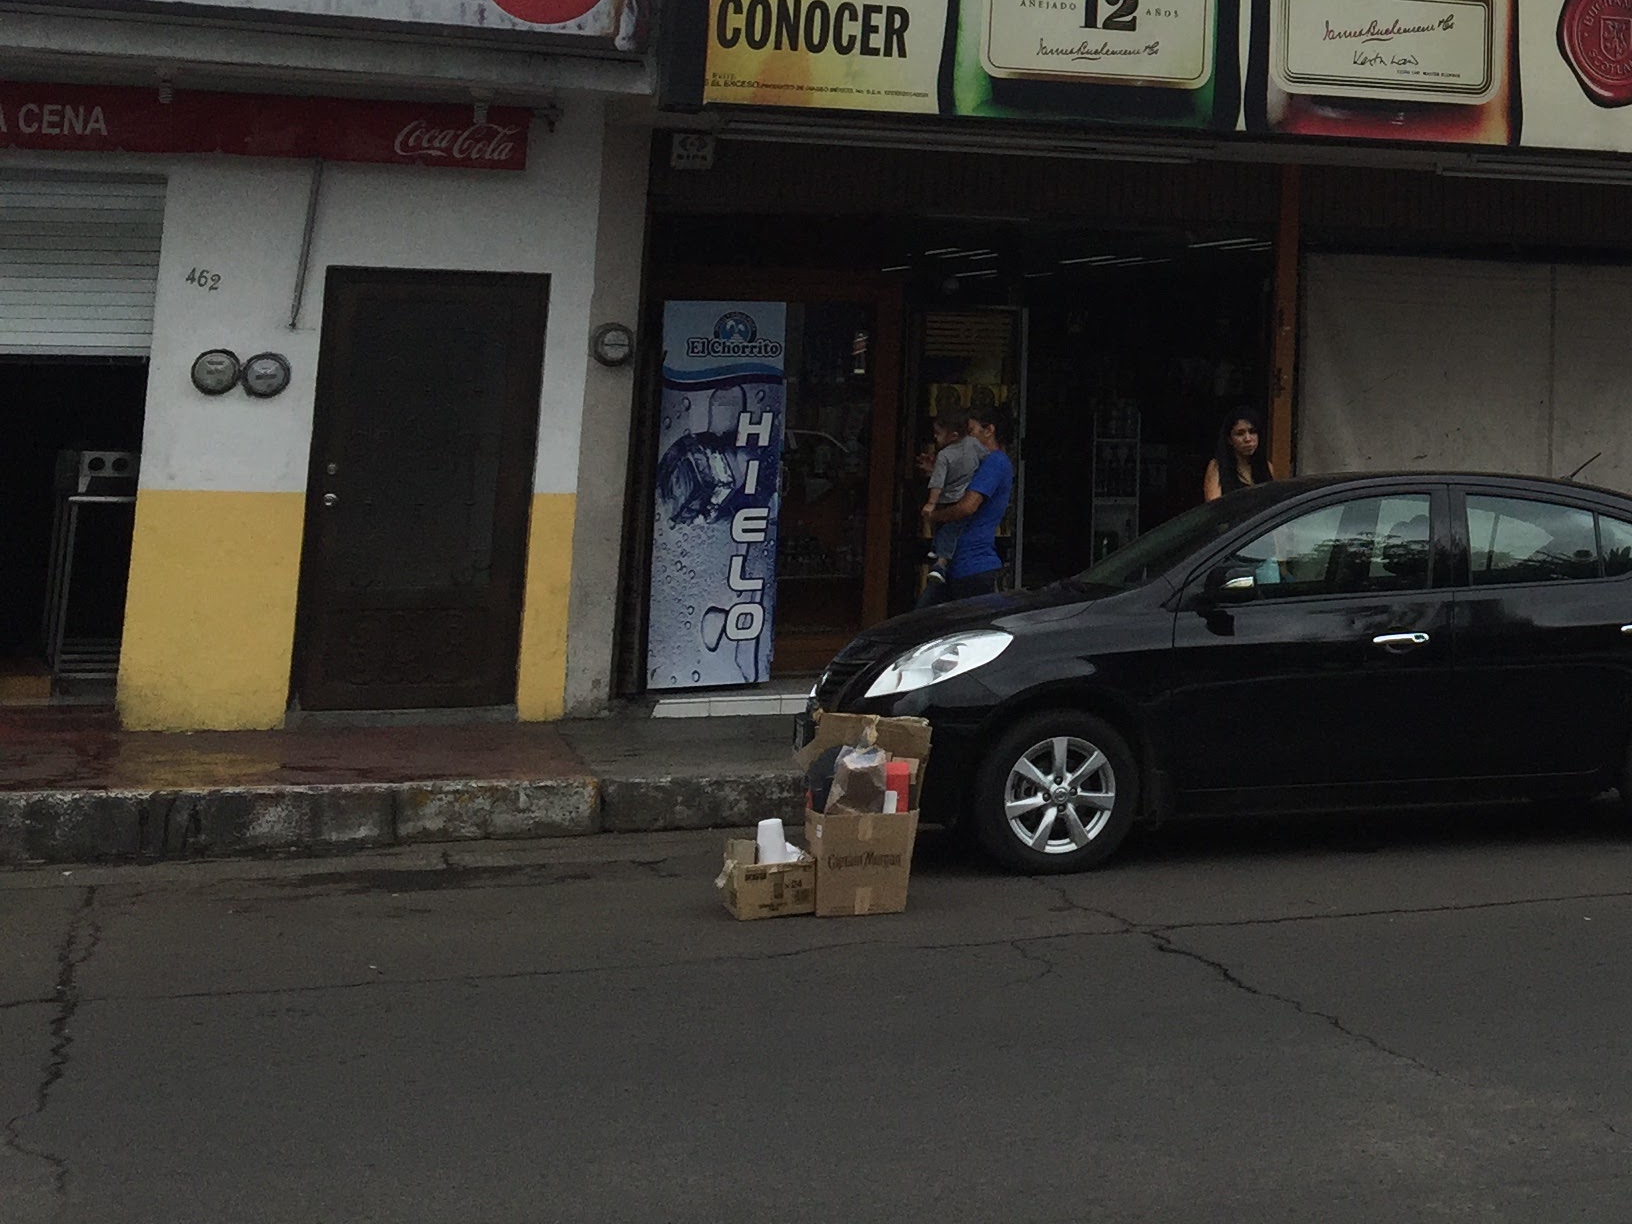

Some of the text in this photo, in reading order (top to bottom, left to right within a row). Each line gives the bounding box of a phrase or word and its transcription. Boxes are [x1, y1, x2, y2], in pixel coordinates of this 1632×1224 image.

[1145, 7, 1179, 19] AÑOS
[18, 103, 108, 136] CENA
[394, 120, 521, 163] Coca-Cola
[186, 267, 222, 292] 462
[687, 337, 783, 358] El Chorrito
[723, 410, 775, 642] HIELO
